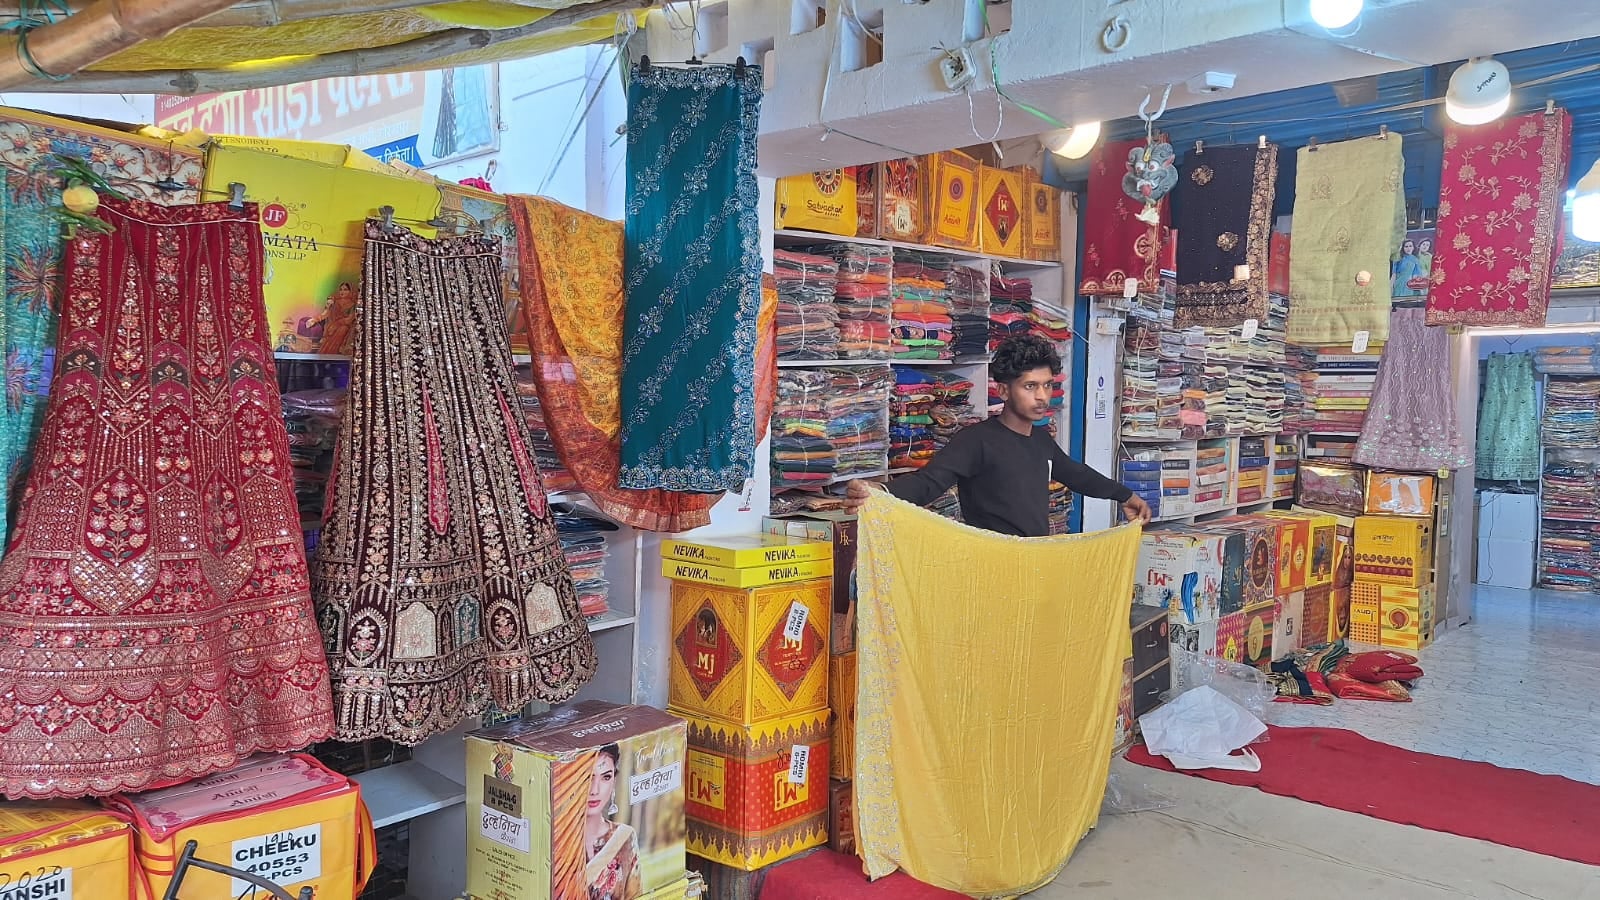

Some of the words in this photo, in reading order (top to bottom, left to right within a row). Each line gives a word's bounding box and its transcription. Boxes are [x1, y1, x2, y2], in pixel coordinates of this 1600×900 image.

[265, 208, 284, 222] JF
[263, 232, 318, 252] MATA
[673, 545, 705, 559] NEVIKA
[765, 549, 796, 562] NEVIKA
[675, 566, 708, 580] NEVIKA
[769, 566, 798, 580] NEVIKA
[498, 800, 514, 812] PCS
[235, 833, 316, 861] CHEEKU
[246, 852, 310, 874] 40553
[260, 866, 303, 880] -PCS
[3, 878, 65, 900] ANSHI
